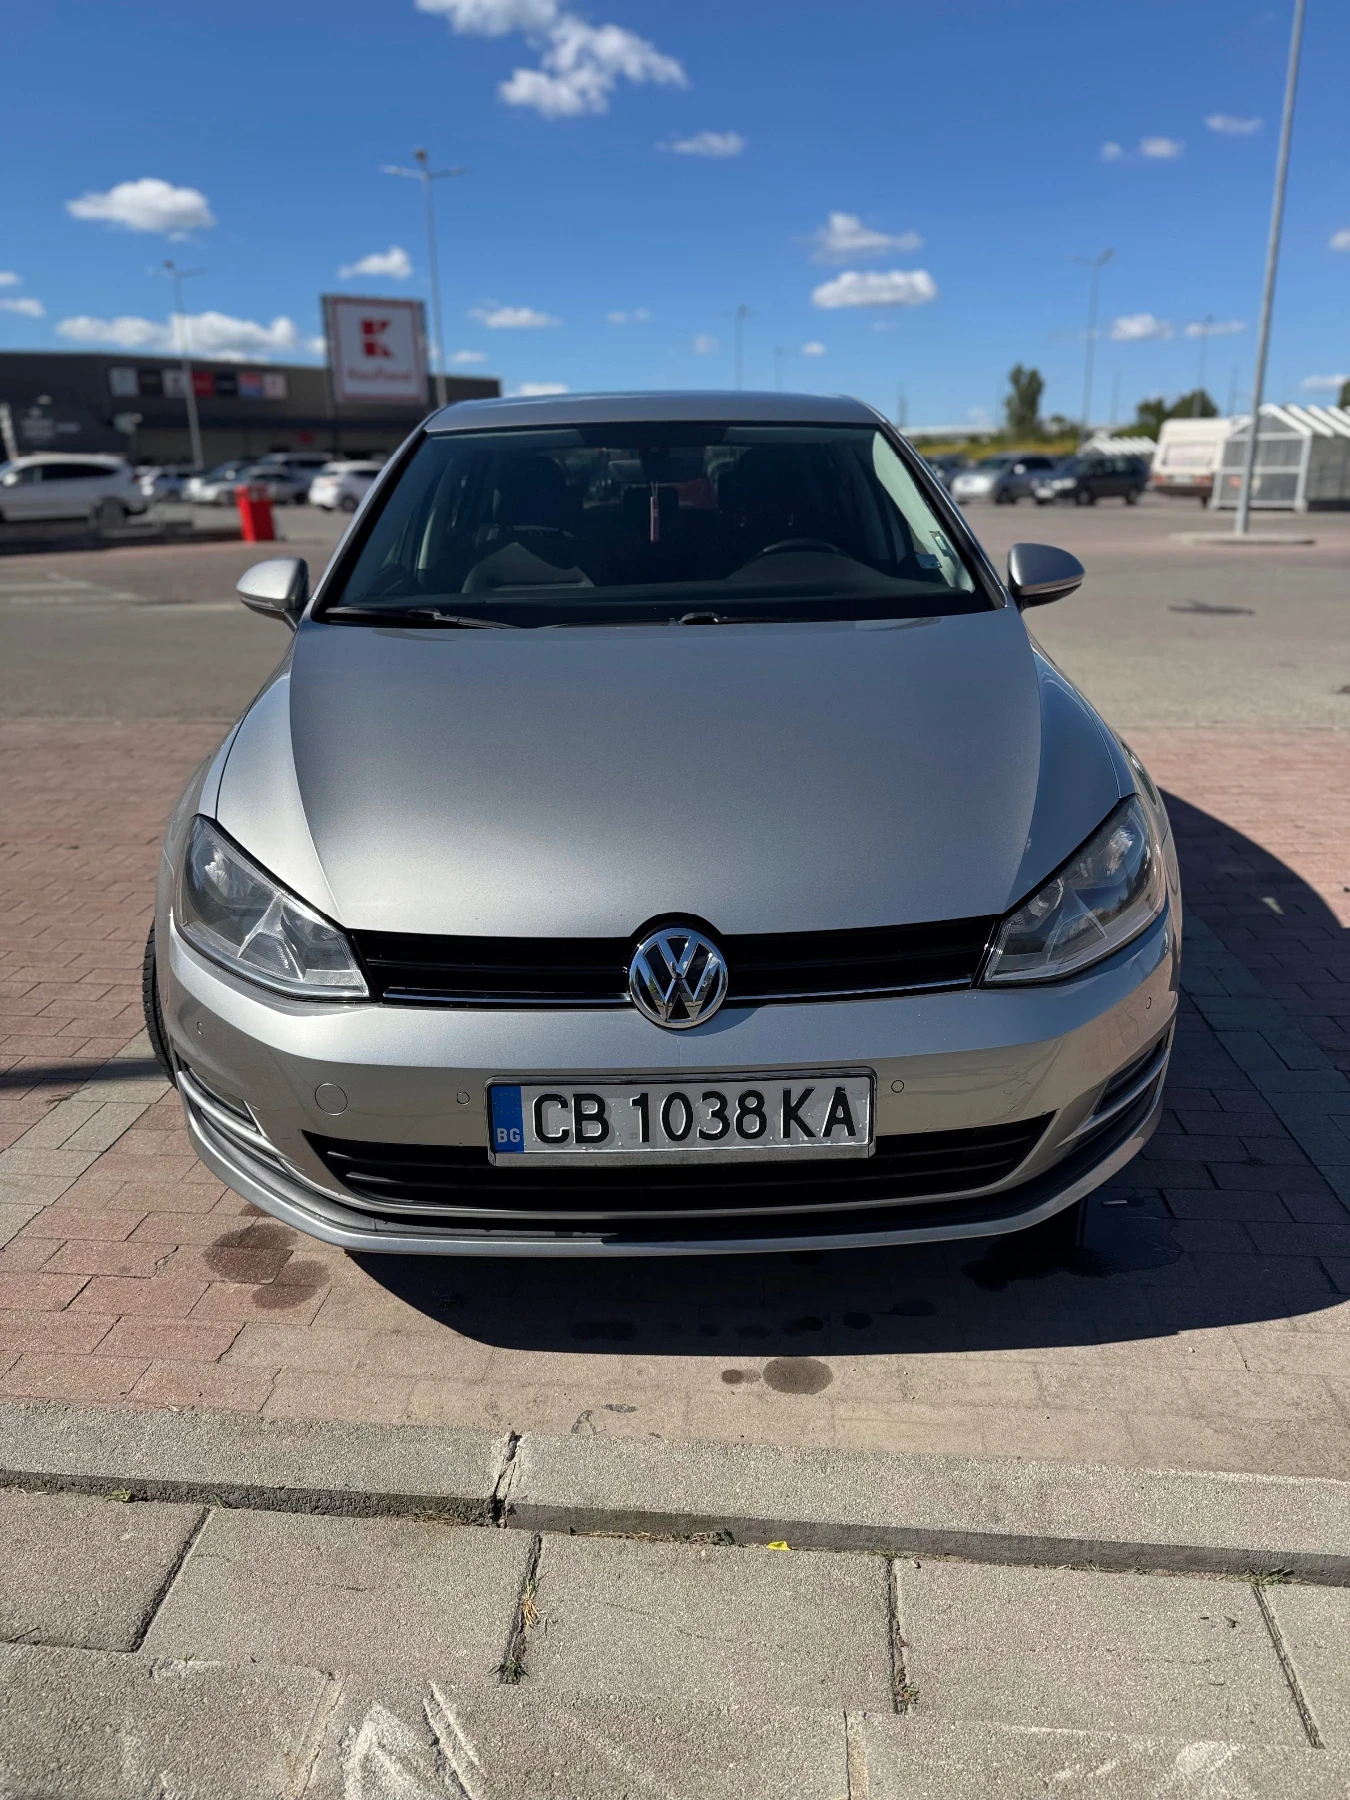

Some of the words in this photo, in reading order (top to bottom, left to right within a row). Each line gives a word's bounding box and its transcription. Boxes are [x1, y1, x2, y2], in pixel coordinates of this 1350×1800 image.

[361, 318, 393, 358] K
[630, 928, 728, 1028] VW
[496, 1127, 521, 1143] BG
[532, 1092, 610, 1144] CB
[630, 1089, 768, 1143] 1038
[782, 1086, 857, 1139] KA
